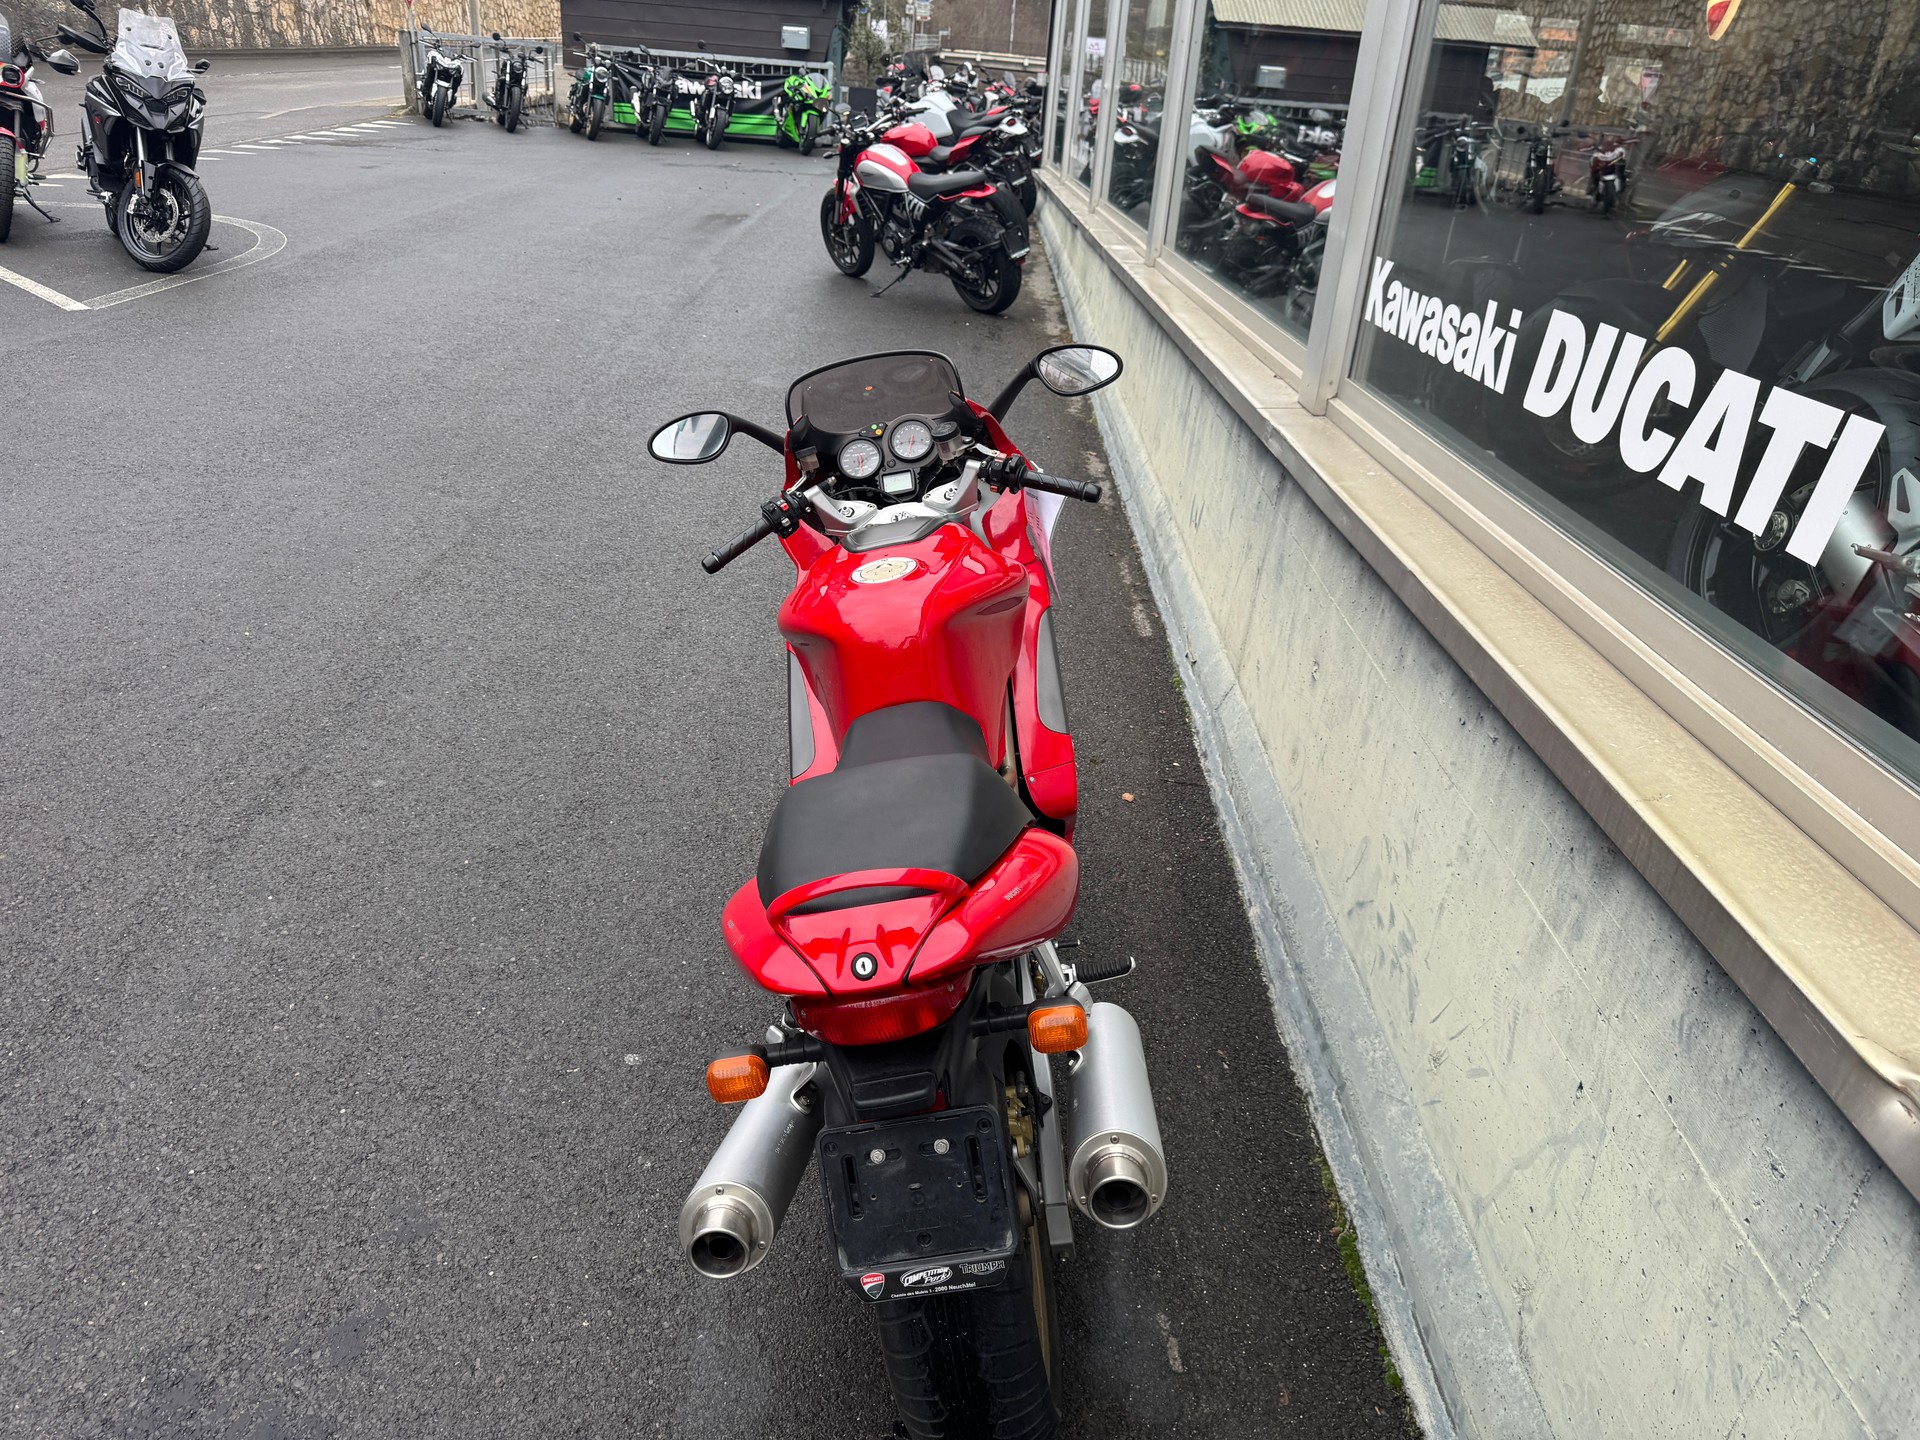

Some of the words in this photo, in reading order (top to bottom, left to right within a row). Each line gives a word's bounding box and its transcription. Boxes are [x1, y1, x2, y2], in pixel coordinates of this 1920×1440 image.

[1364, 256, 1523, 395] Kawasaki
[1523, 308, 1886, 568] DUCATI
[959, 1259, 1005, 1274] TRIUMPH
[863, 1275, 883, 1283] DUCATI
[904, 1266, 949, 1287] COMPETITION
[924, 1272, 948, 1284] Park
